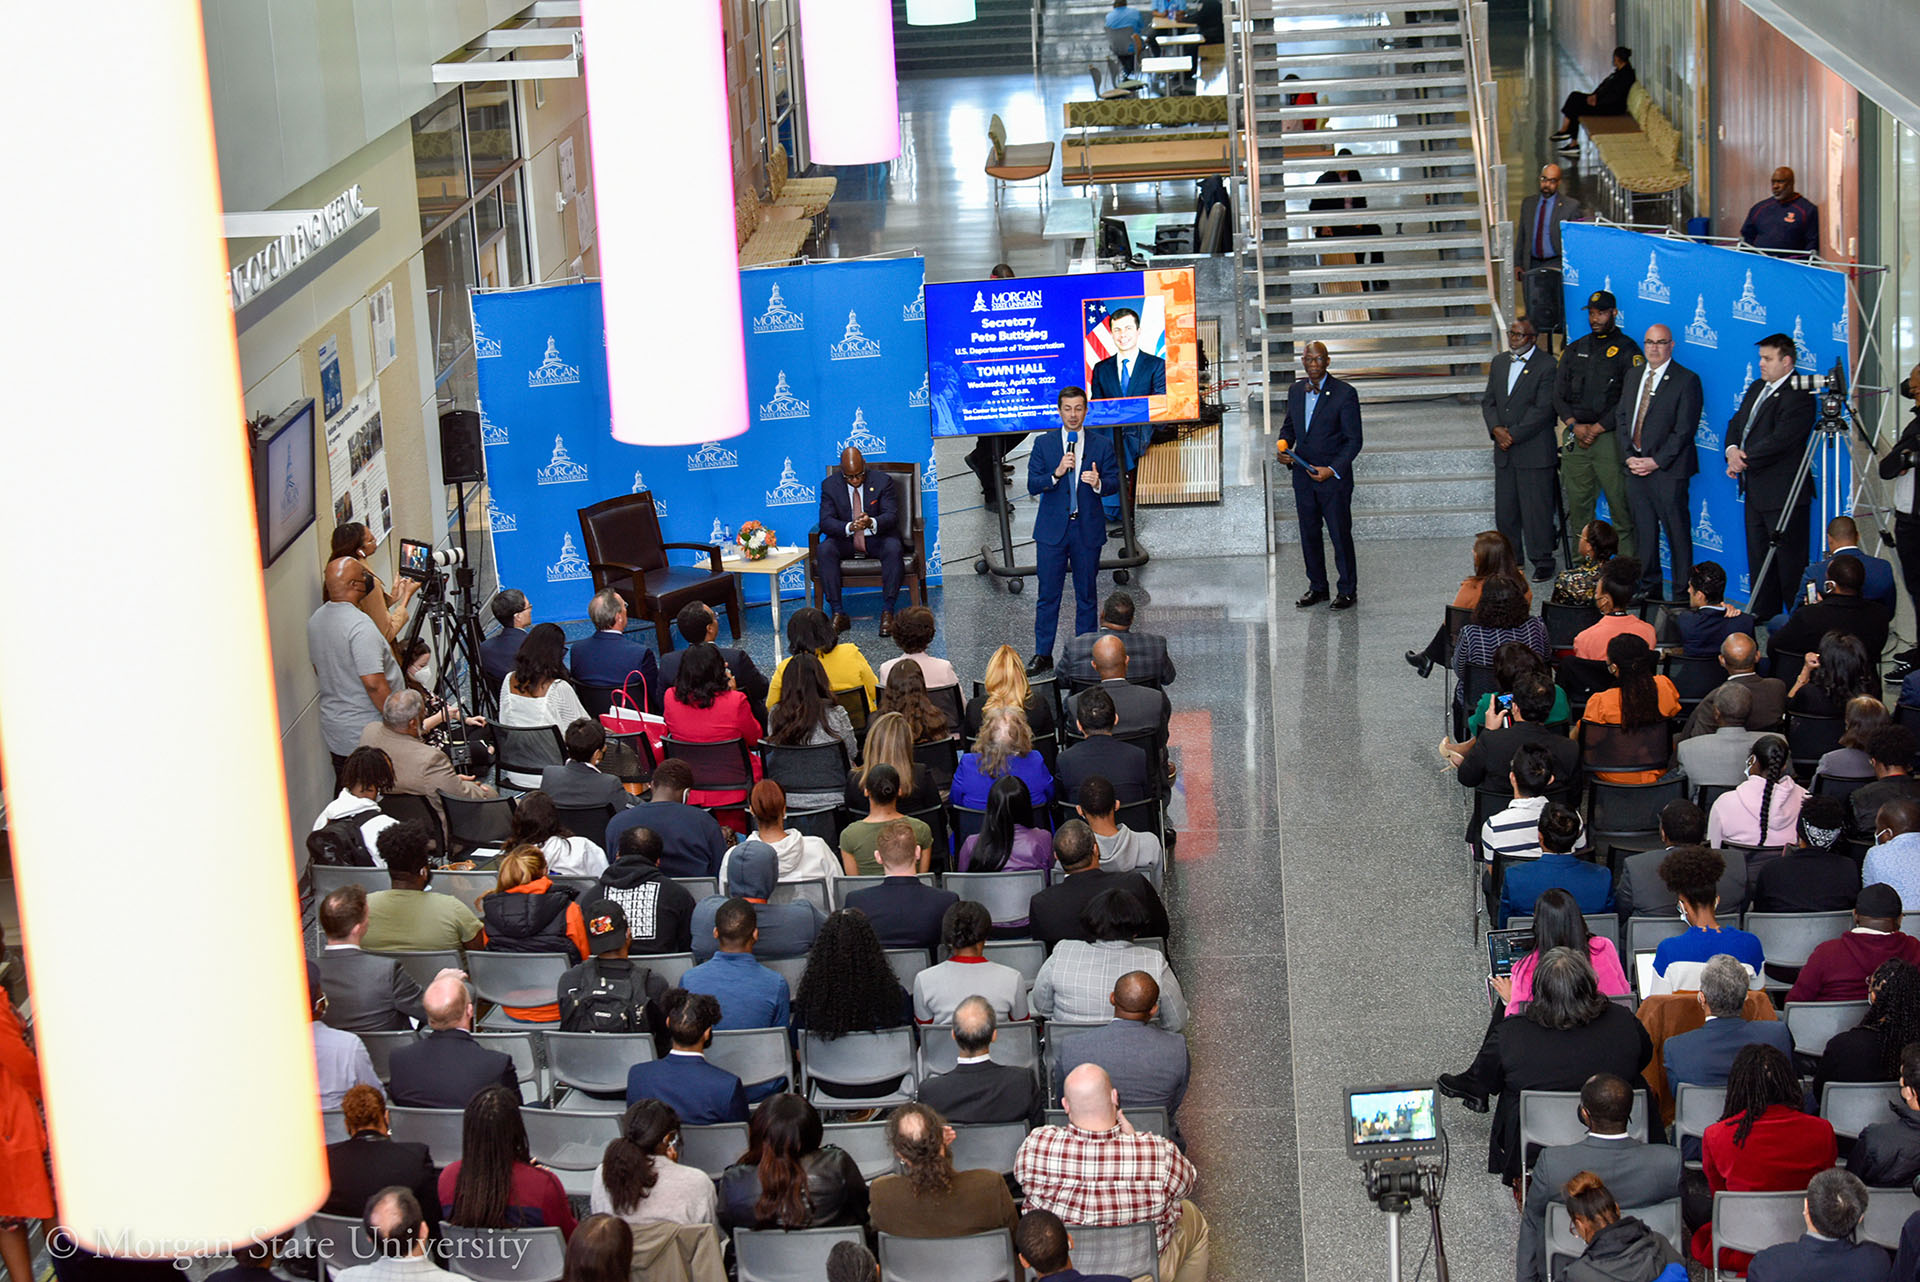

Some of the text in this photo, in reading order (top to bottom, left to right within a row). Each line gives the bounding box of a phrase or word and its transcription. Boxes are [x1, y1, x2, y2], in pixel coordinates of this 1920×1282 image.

[294, 184, 364, 262] ENGINEERING
[992, 290, 1042, 303] MORGAN
[754, 313, 804, 327] MORGAN
[981, 318, 1036, 328] Secretary
[971, 329, 1048, 343] Pete Buttigieg
[476, 340, 501, 351] GAN
[830, 340, 880, 353] MORGAN
[970, 345, 1008, 355] Department
[1018, 342, 1065, 352] Transportation
[529, 365, 579, 380] MORGAN
[976, 363, 1045, 377] TOWN HALL
[967, 380, 1008, 388] Wednesday,
[1010, 378, 1025, 387] April
[760, 400, 809, 414] MORGAN
[483, 427, 508, 438] GAN
[837, 436, 886, 451] MORGAN
[688, 450, 738, 464] MORGAN
[537, 464, 587, 477] MORGAN
[766, 486, 815, 500] MORGAN
[492, 514, 516, 525] GAN
[547, 562, 590, 575] MORGA
